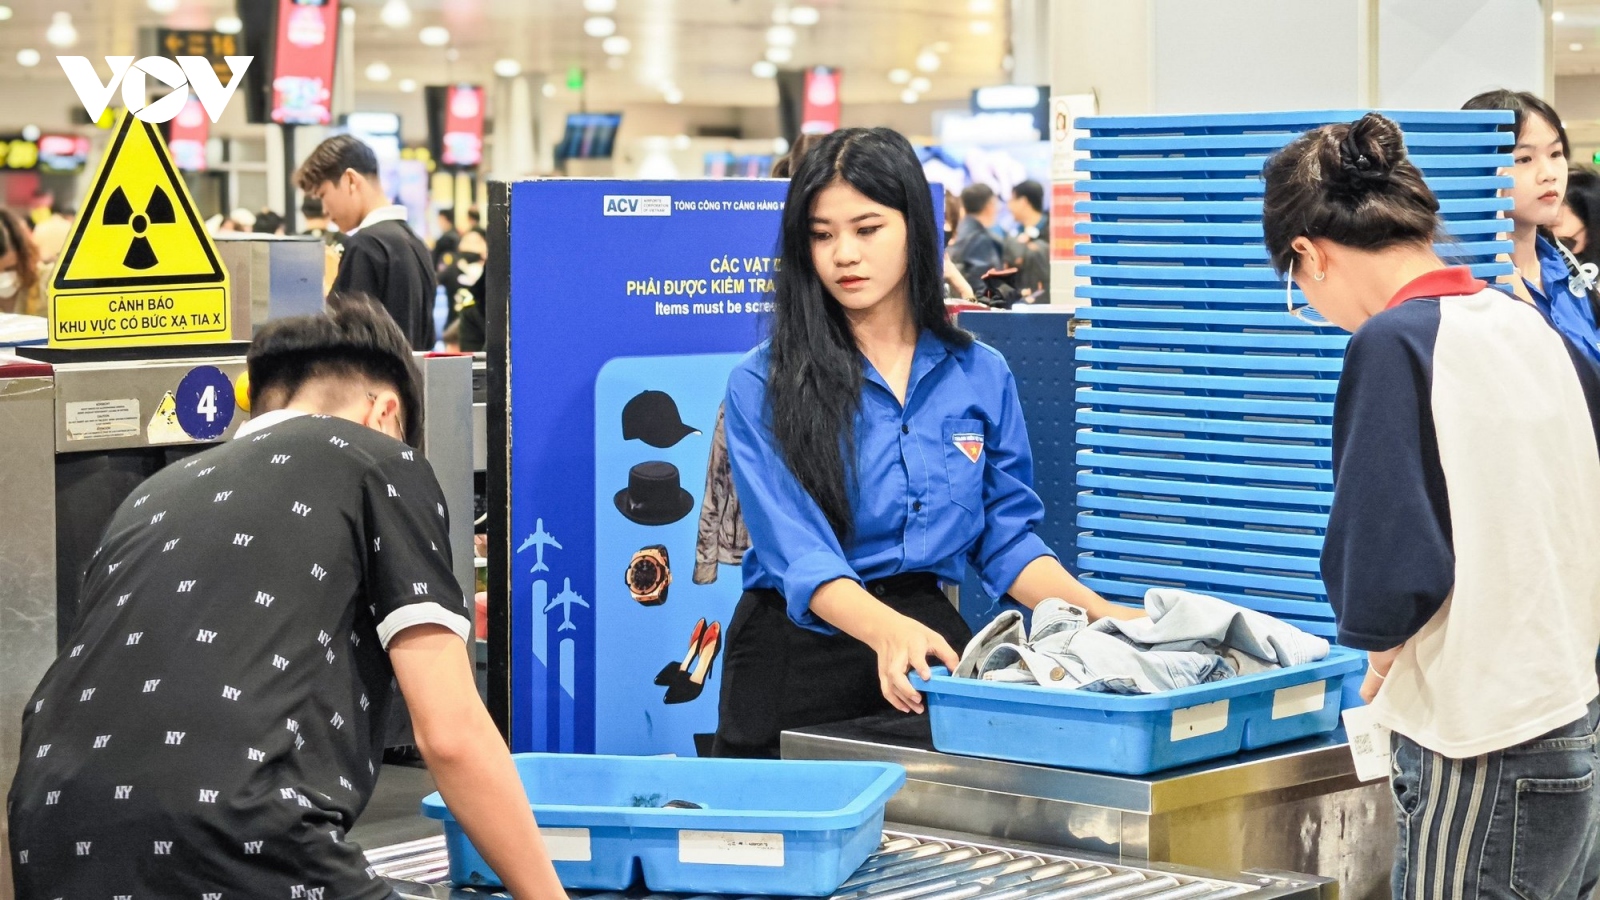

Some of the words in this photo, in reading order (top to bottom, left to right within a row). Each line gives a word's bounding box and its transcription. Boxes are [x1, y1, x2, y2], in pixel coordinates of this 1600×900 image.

[607, 198, 639, 213] ACV
[698, 199, 721, 211] CÔNG
[722, 201, 732, 210] TY
[710, 254, 740, 273] CÁC
[626, 277, 660, 296] PHẢI
[664, 279, 708, 298] ĐƯỢC
[108, 296, 144, 312] CẢNH
[147, 295, 174, 310] BÁO
[655, 301, 690, 316] Items
[693, 300, 724, 315] must
[727, 300, 742, 314] be
[59, 320, 86, 334] KHU
[90, 317, 116, 335] VỰC
[120, 315, 138, 330] CÓ
[141, 314, 167, 329] BỨC
[170, 314, 188, 330] XẠ
[190, 313, 210, 326] TIA
[213, 313, 221, 324] X
[197, 385, 217, 422] 4
[329, 436, 349, 448] NY
[271, 454, 291, 464] NY
[401, 450, 414, 461] NY
[133, 494, 150, 508] NY
[214, 491, 233, 502] NY
[292, 501, 311, 517] NY
[151, 511, 166, 524] NY
[162, 538, 180, 552] NY
[233, 533, 254, 547] NY
[311, 563, 327, 581] NY
[177, 580, 196, 592] NY
[413, 582, 428, 595] NY
[255, 591, 275, 607] NY
[126, 632, 143, 645] NY
[196, 629, 218, 643] NY
[318, 630, 331, 647] NY
[70, 644, 84, 658] NY
[272, 654, 289, 671] NY
[142, 679, 161, 692] NY
[80, 688, 96, 702] NY
[222, 685, 241, 701] NY
[330, 712, 344, 729] NY
[93, 735, 112, 748] NY
[165, 731, 186, 745] NY
[36, 744, 51, 758] NY
[247, 748, 266, 762] NY
[46, 791, 61, 805] NY
[114, 786, 133, 799] NY
[198, 789, 219, 803] NY
[76, 842, 91, 855] NY
[154, 841, 173, 854] NY
[244, 841, 263, 854] NY
